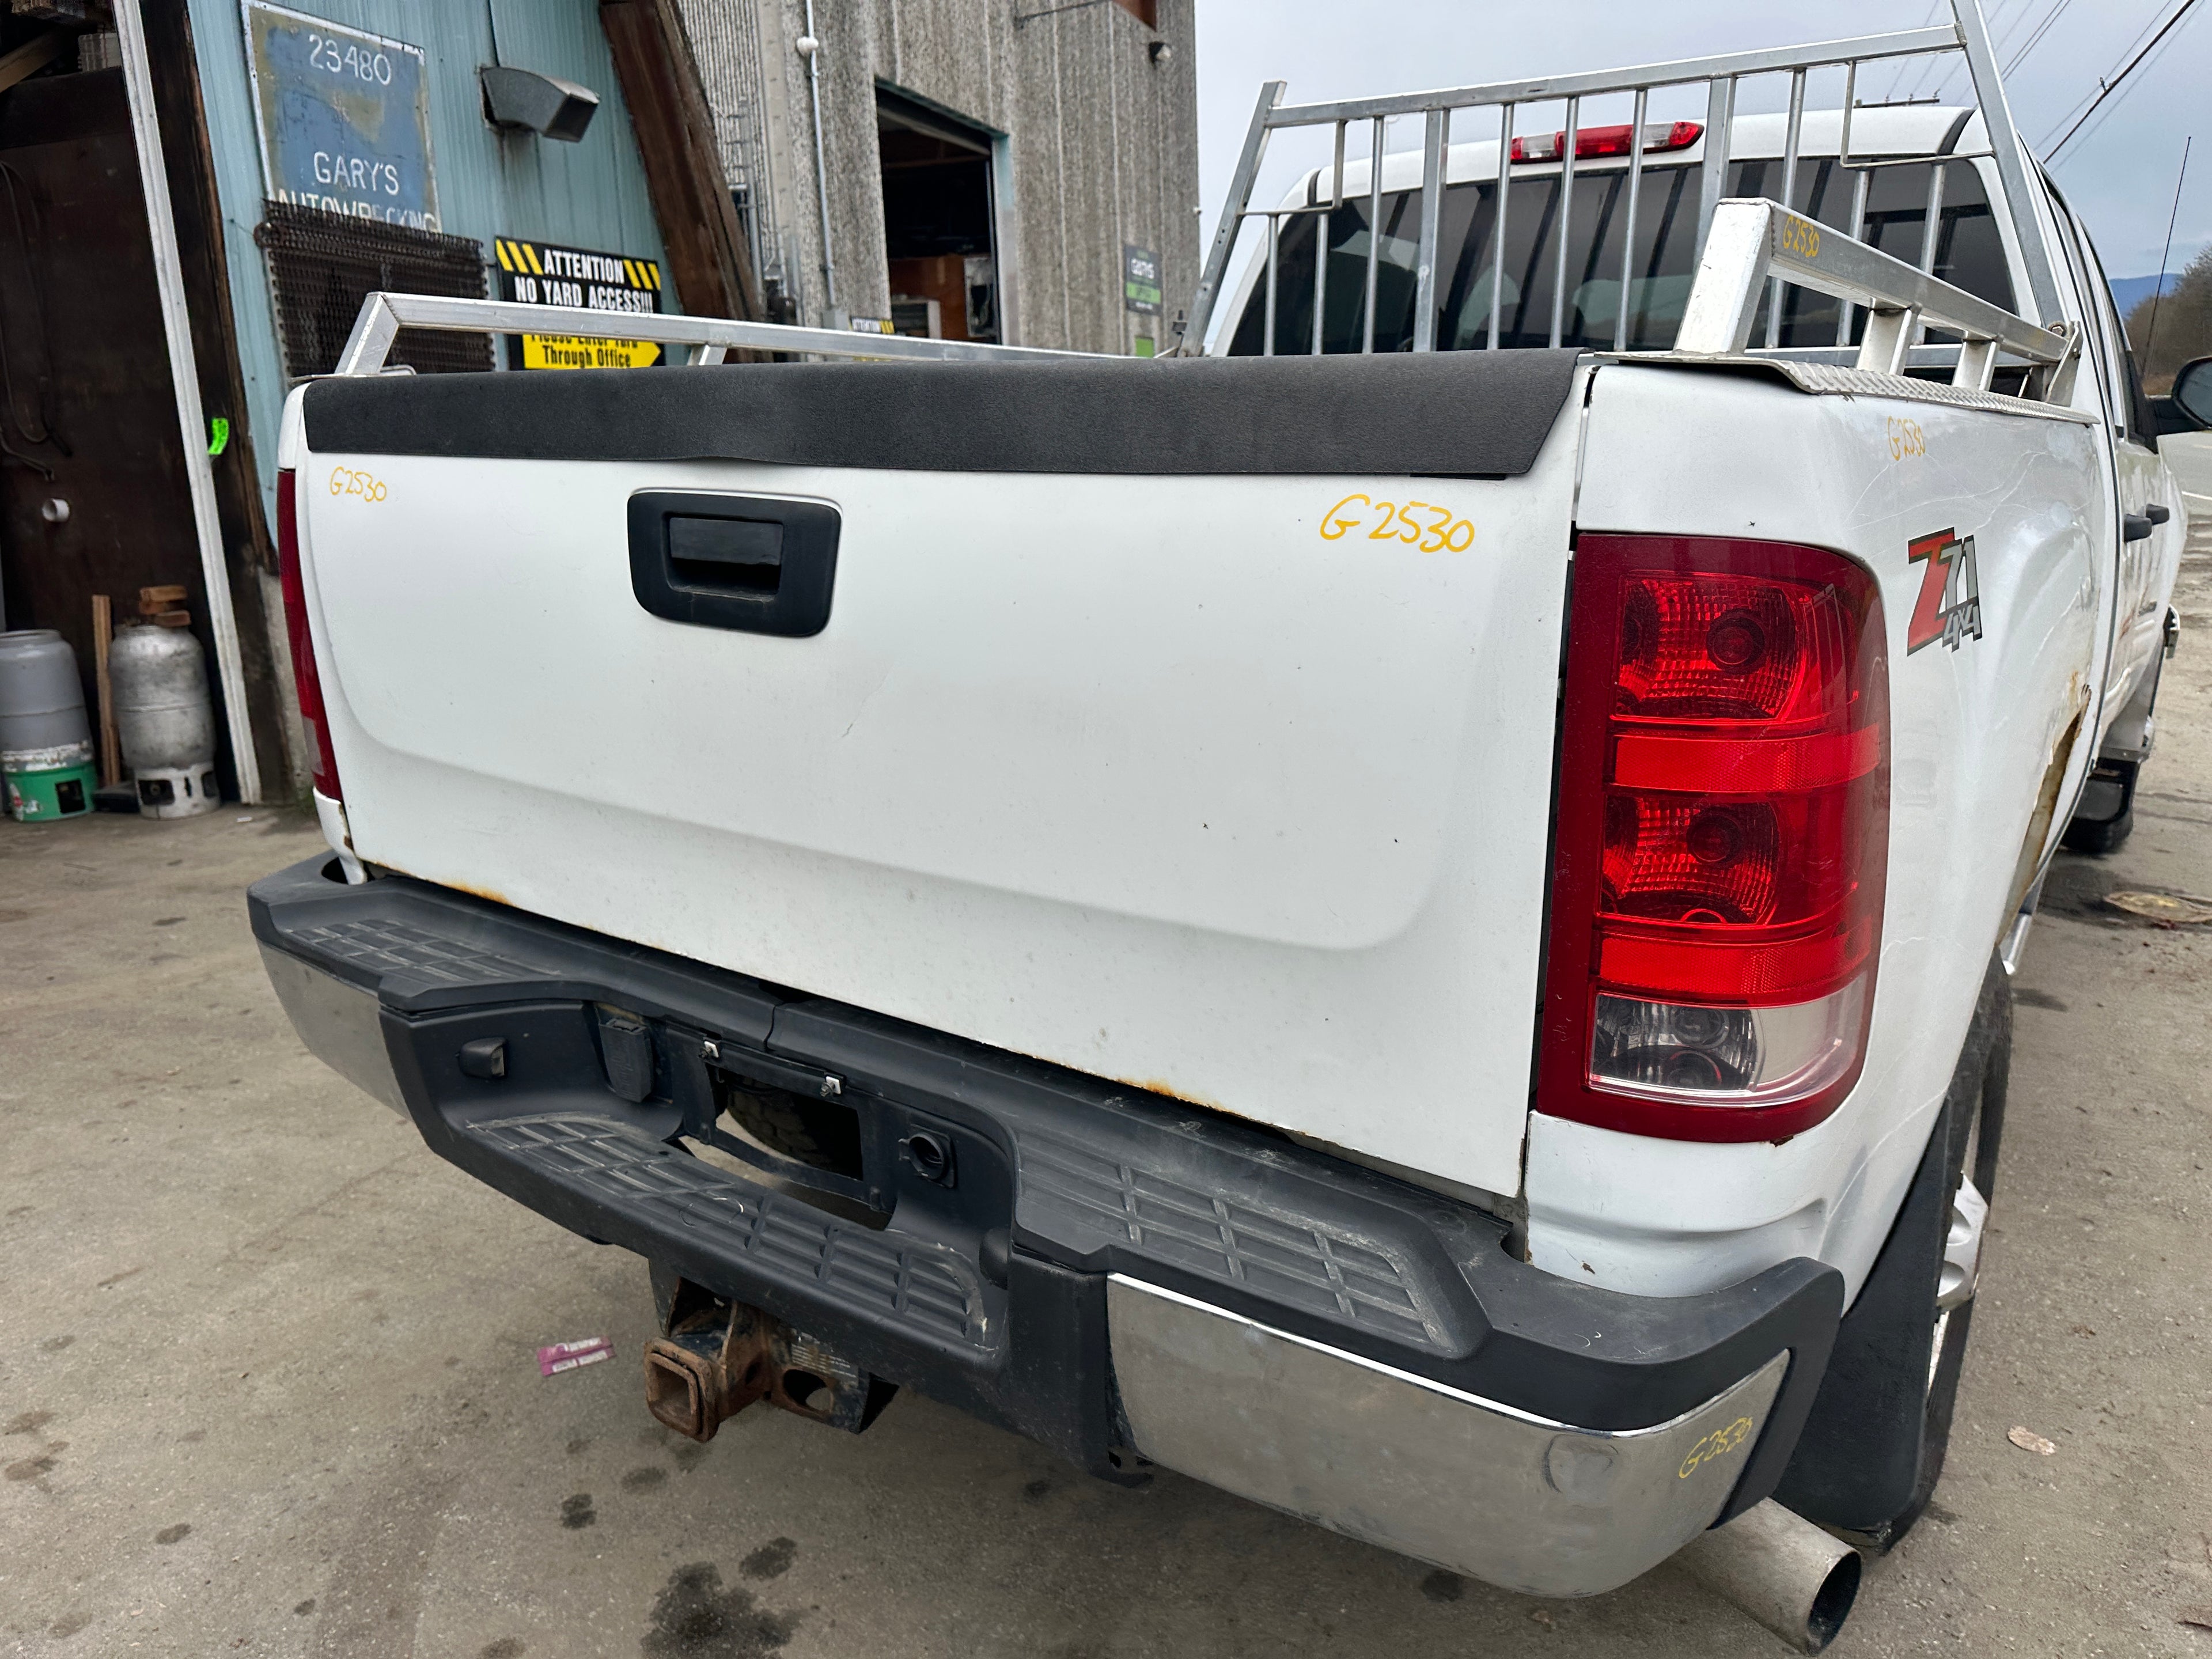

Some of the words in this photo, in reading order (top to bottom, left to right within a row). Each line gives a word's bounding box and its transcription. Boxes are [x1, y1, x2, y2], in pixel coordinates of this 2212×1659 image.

[309, 34, 391, 85] 23480
[313, 151, 399, 195] GARY'S
[1783, 214, 1820, 258] G2530
[544, 249, 625, 284] ATTENTION
[514, 276, 537, 303] NO
[541, 279, 582, 307] YARD
[588, 285, 654, 313] ACCESS!!!
[543, 345, 592, 368] Through
[597, 349, 631, 368] Office
[330, 466, 387, 502] G2530
[1320, 493, 1475, 553] G2530
[1907, 527, 1979, 657] Z71
